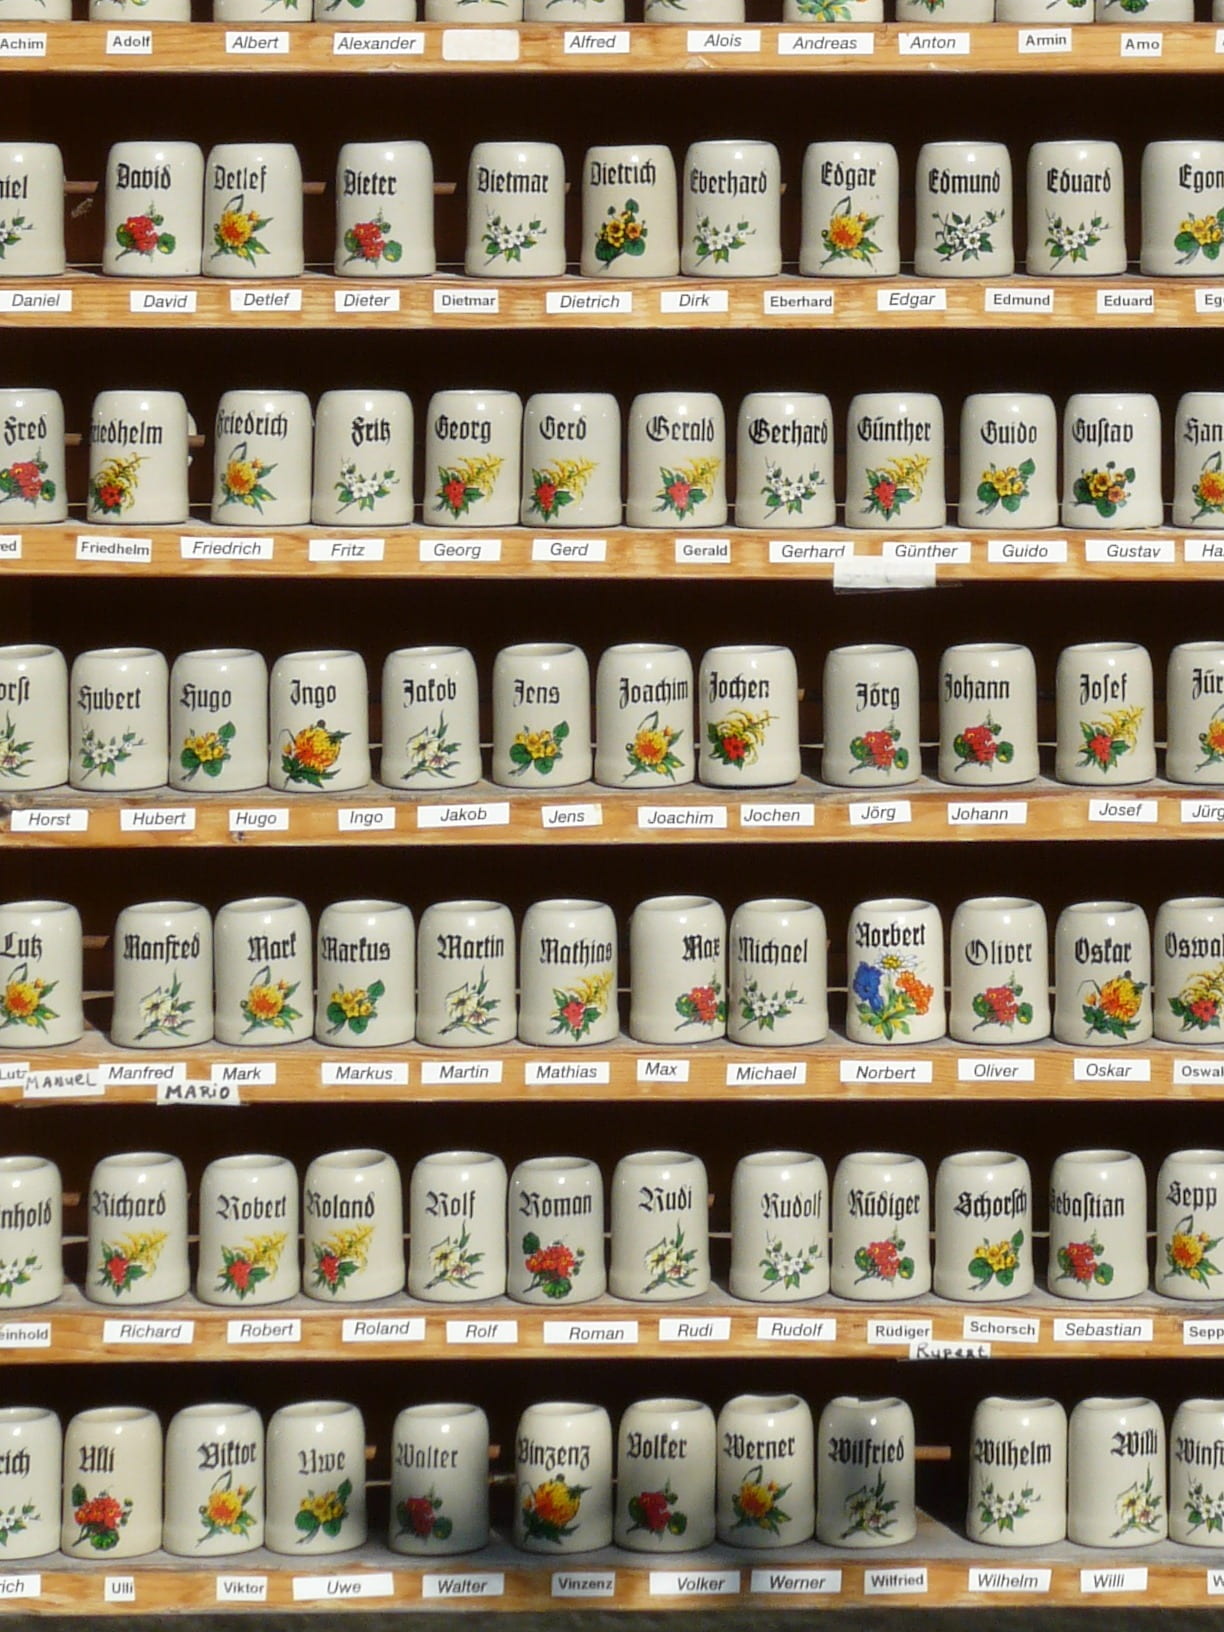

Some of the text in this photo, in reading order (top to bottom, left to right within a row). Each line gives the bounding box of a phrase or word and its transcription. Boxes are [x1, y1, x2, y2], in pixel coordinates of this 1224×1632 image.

[232, 36, 279, 49] Albert
[337, 36, 417, 50] Alexander
[792, 36, 857, 50] Andreas
[910, 36, 956, 49] Anton
[11, 293, 60, 307] Daniel
[143, 294, 188, 308] David
[559, 295, 620, 309] Dietrich
[889, 292, 936, 309] Edgar
[1104, 295, 1153, 307] Eduard
[81, 541, 150, 556] Friedhelm
[433, 543, 482, 560] Georg
[550, 542, 589, 556] Gerd
[1002, 544, 1048, 558] Guido
[132, 812, 186, 825] Hubert
[548, 810, 585, 824] Jens
[647, 811, 714, 825] Joachim
[335, 1066, 393, 1080] Markus
[536, 1065, 597, 1079] Mathias
[736, 1066, 797, 1080] Michael
[856, 1065, 916, 1079] Norbert
[1086, 1063, 1132, 1077] Oskar
[120, 1325, 181, 1338] Richard
[569, 1326, 624, 1340] Roman
[771, 1322, 823, 1337] Rudolf
[1065, 1322, 1142, 1337] Sebastian
[438, 1579, 488, 1594] Walter
[557, 1576, 612, 1590] Vinzenz
[870, 1574, 924, 1588] Wilfried
[978, 1574, 1038, 1588] Wilhelm
